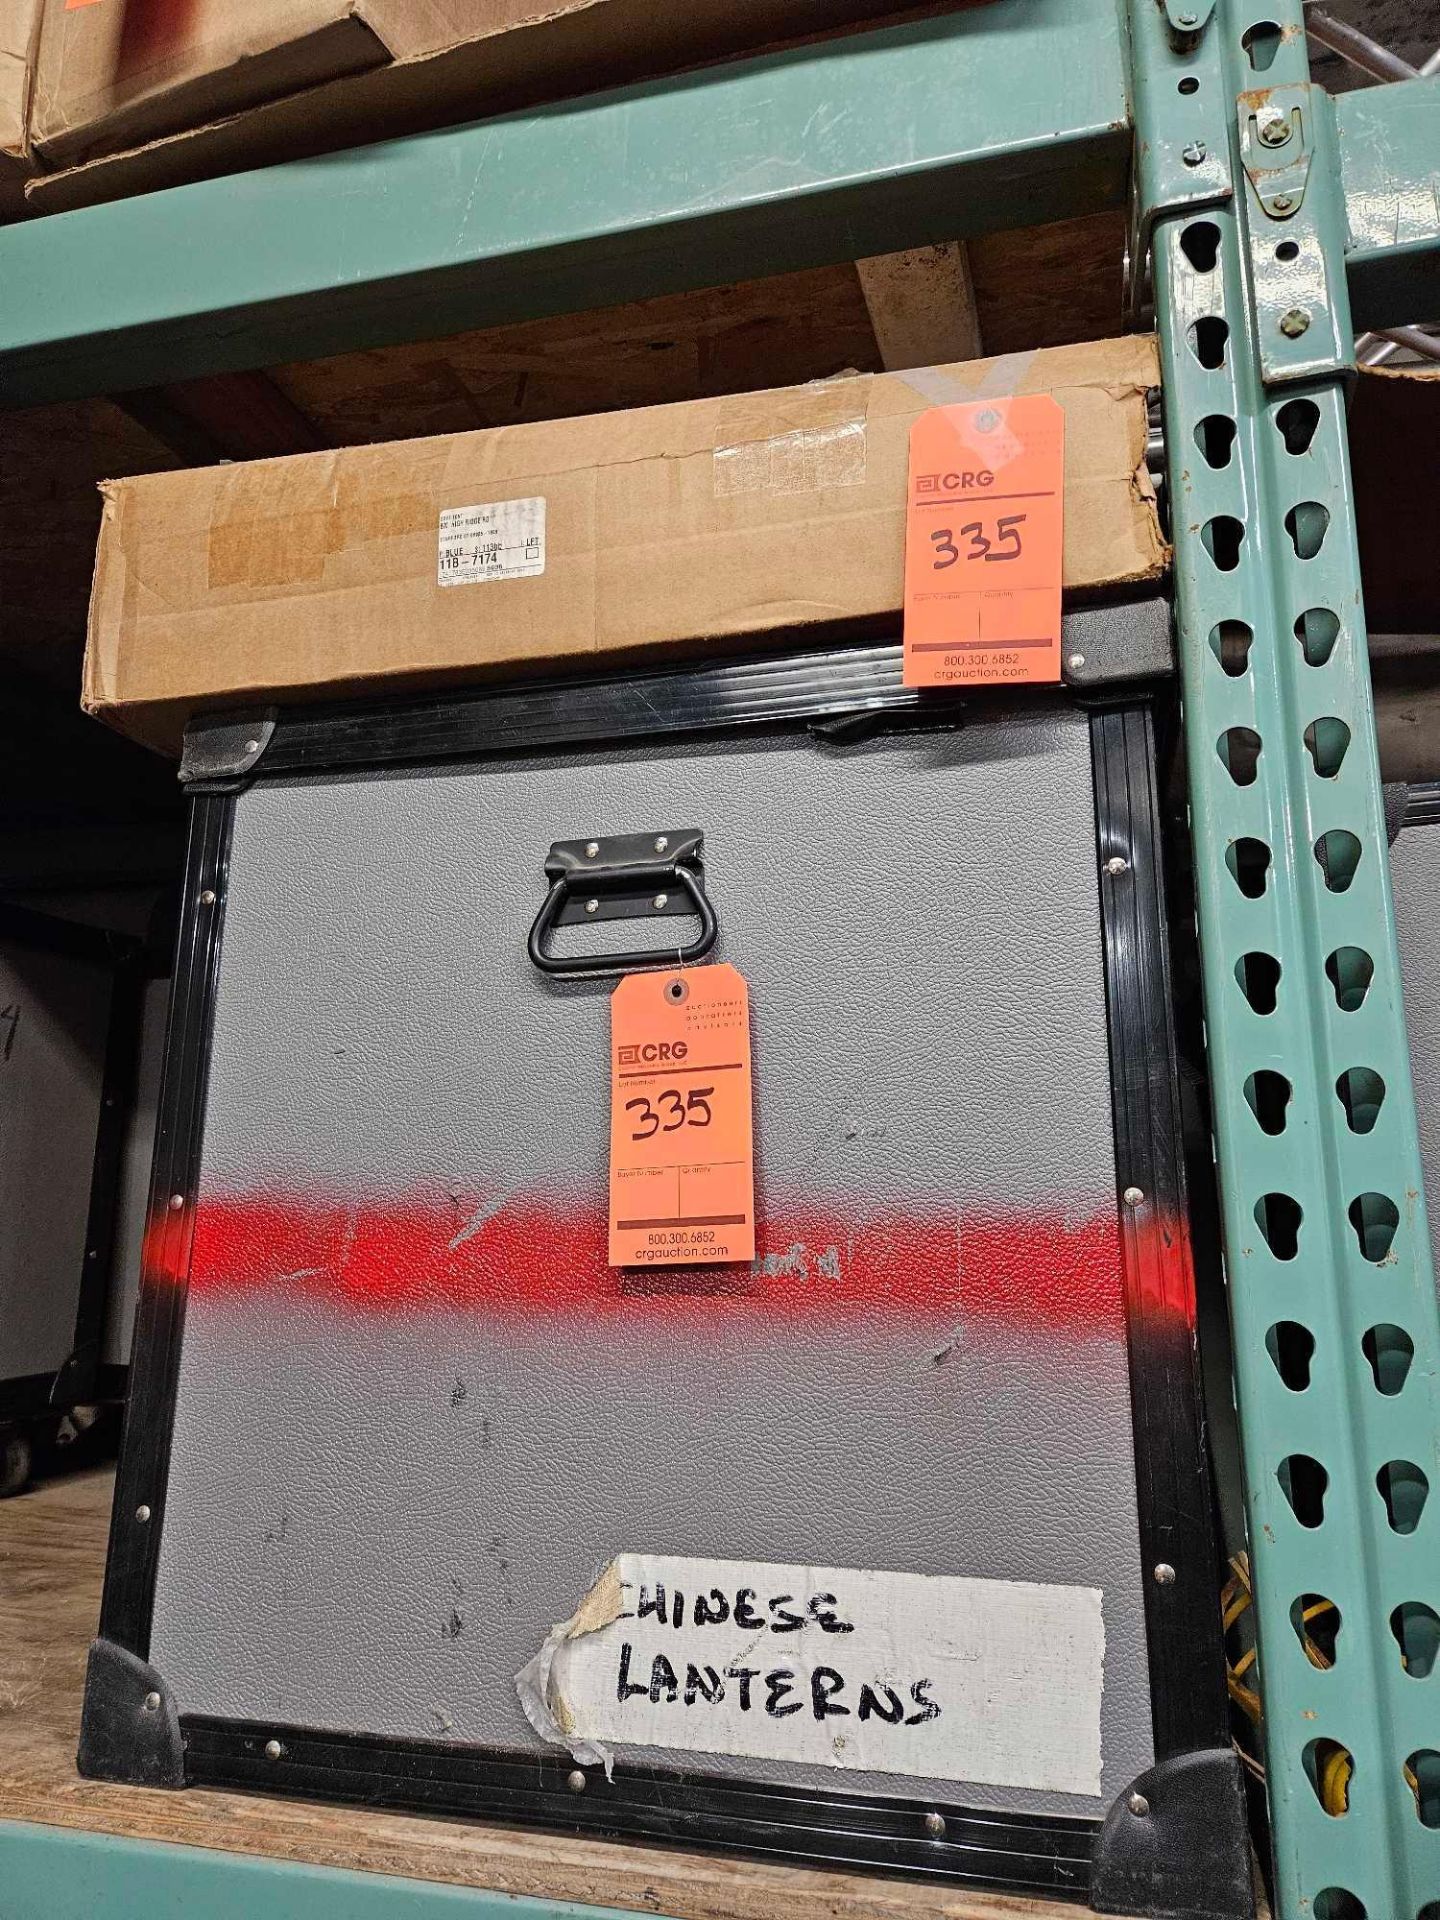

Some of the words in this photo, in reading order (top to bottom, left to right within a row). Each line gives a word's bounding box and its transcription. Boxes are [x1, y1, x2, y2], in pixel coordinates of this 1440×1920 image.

[942, 470, 994, 490] CRG
[930, 514, 1027, 570] 335
[446, 548, 463, 557] BLUE
[934, 667, 1028, 680] crgauction.com
[642, 1041, 688, 1062] CRG
[626, 1086, 714, 1142] 335
[648, 1231, 716, 1244] 800.300.6852
[636, 1245, 729, 1261] crgauction.com
[617, 1641, 942, 1726] LANTERNS
